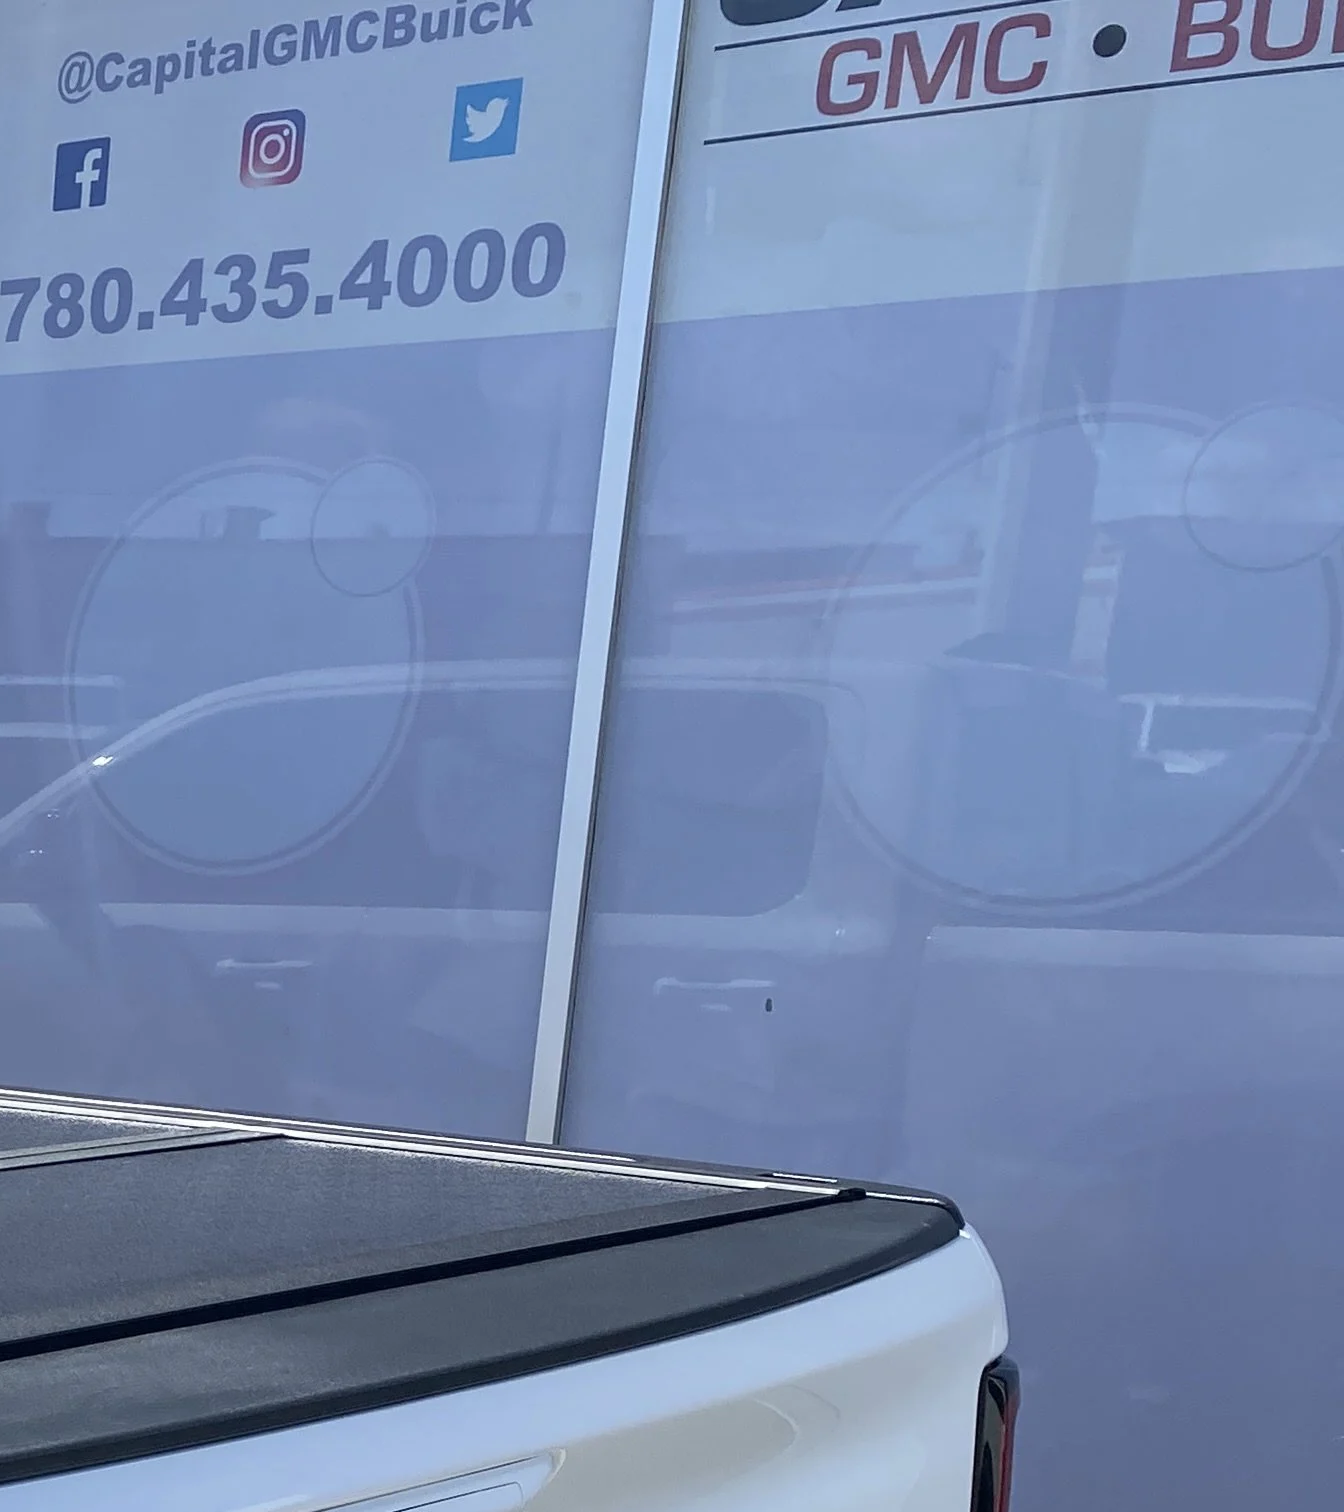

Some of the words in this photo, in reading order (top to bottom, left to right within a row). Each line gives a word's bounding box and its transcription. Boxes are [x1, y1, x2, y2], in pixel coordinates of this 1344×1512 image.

[58, 0, 534, 104] @CapitalGMCBuick
[815, 12, 1052, 116] GMC
[0, 221, 567, 342] 780.435.4000
